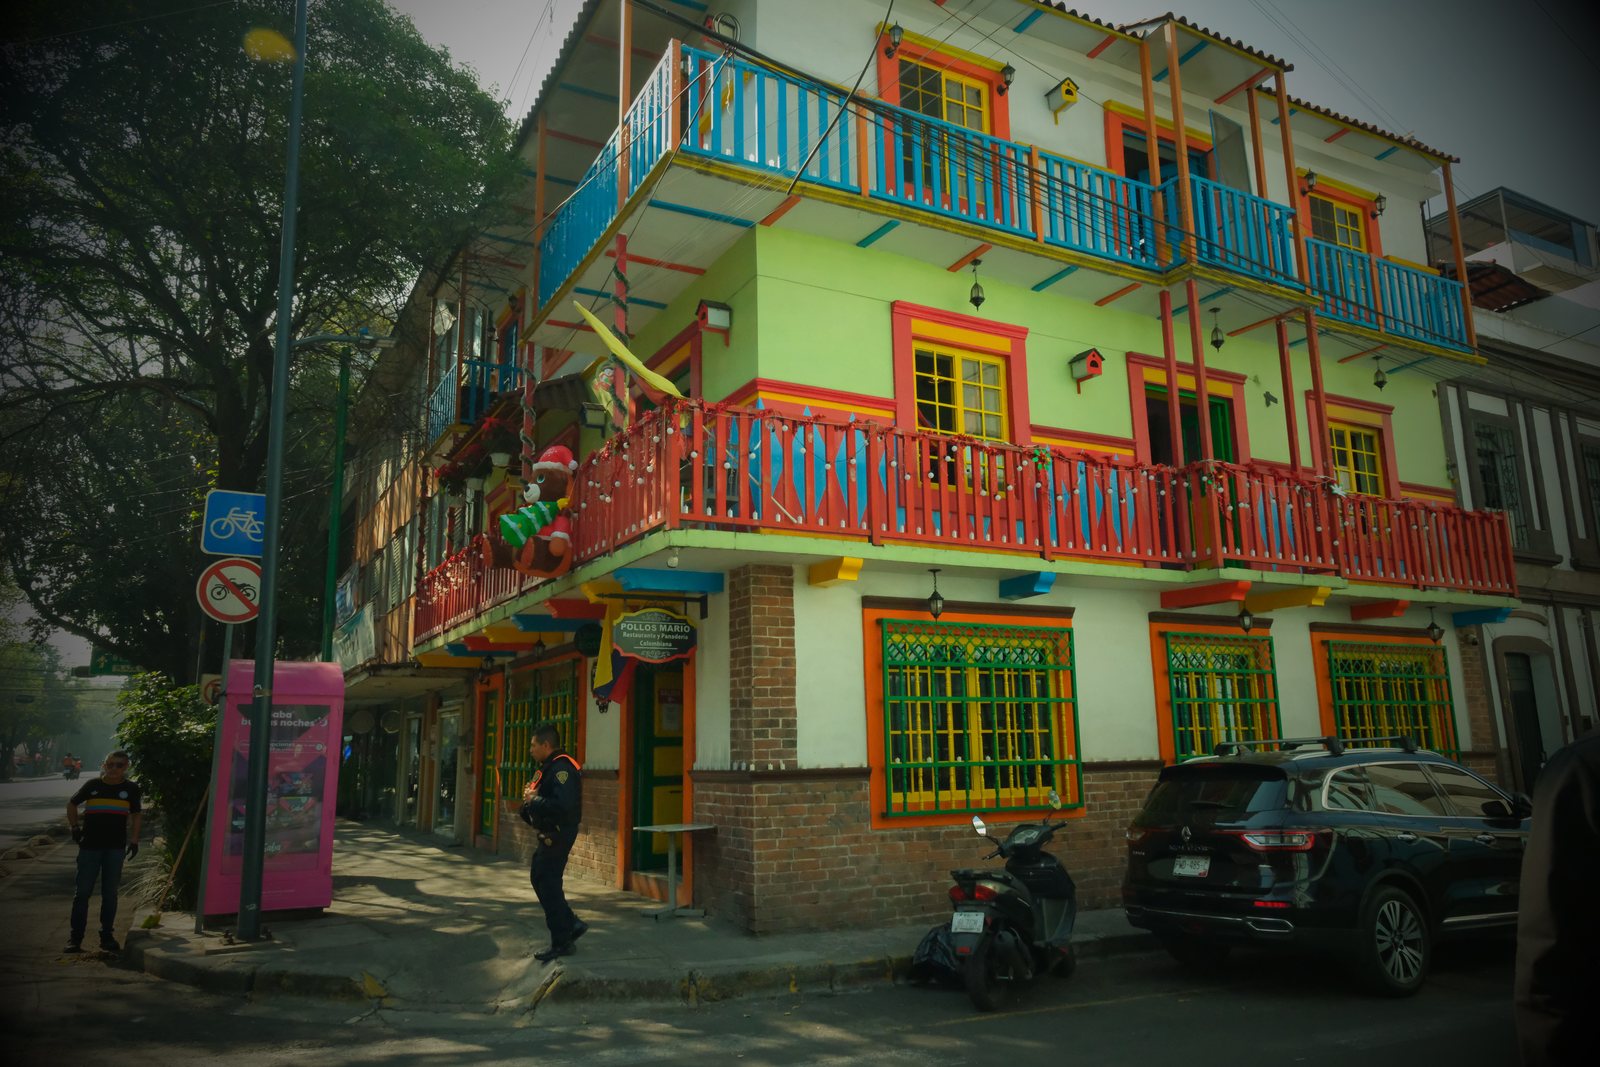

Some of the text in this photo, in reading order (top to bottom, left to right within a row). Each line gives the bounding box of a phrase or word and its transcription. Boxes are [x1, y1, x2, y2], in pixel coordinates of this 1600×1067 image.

[620, 623, 691, 633] POLLOS MARIO
[272, 710, 292, 718] aba
[280, 718, 315, 727] noches
